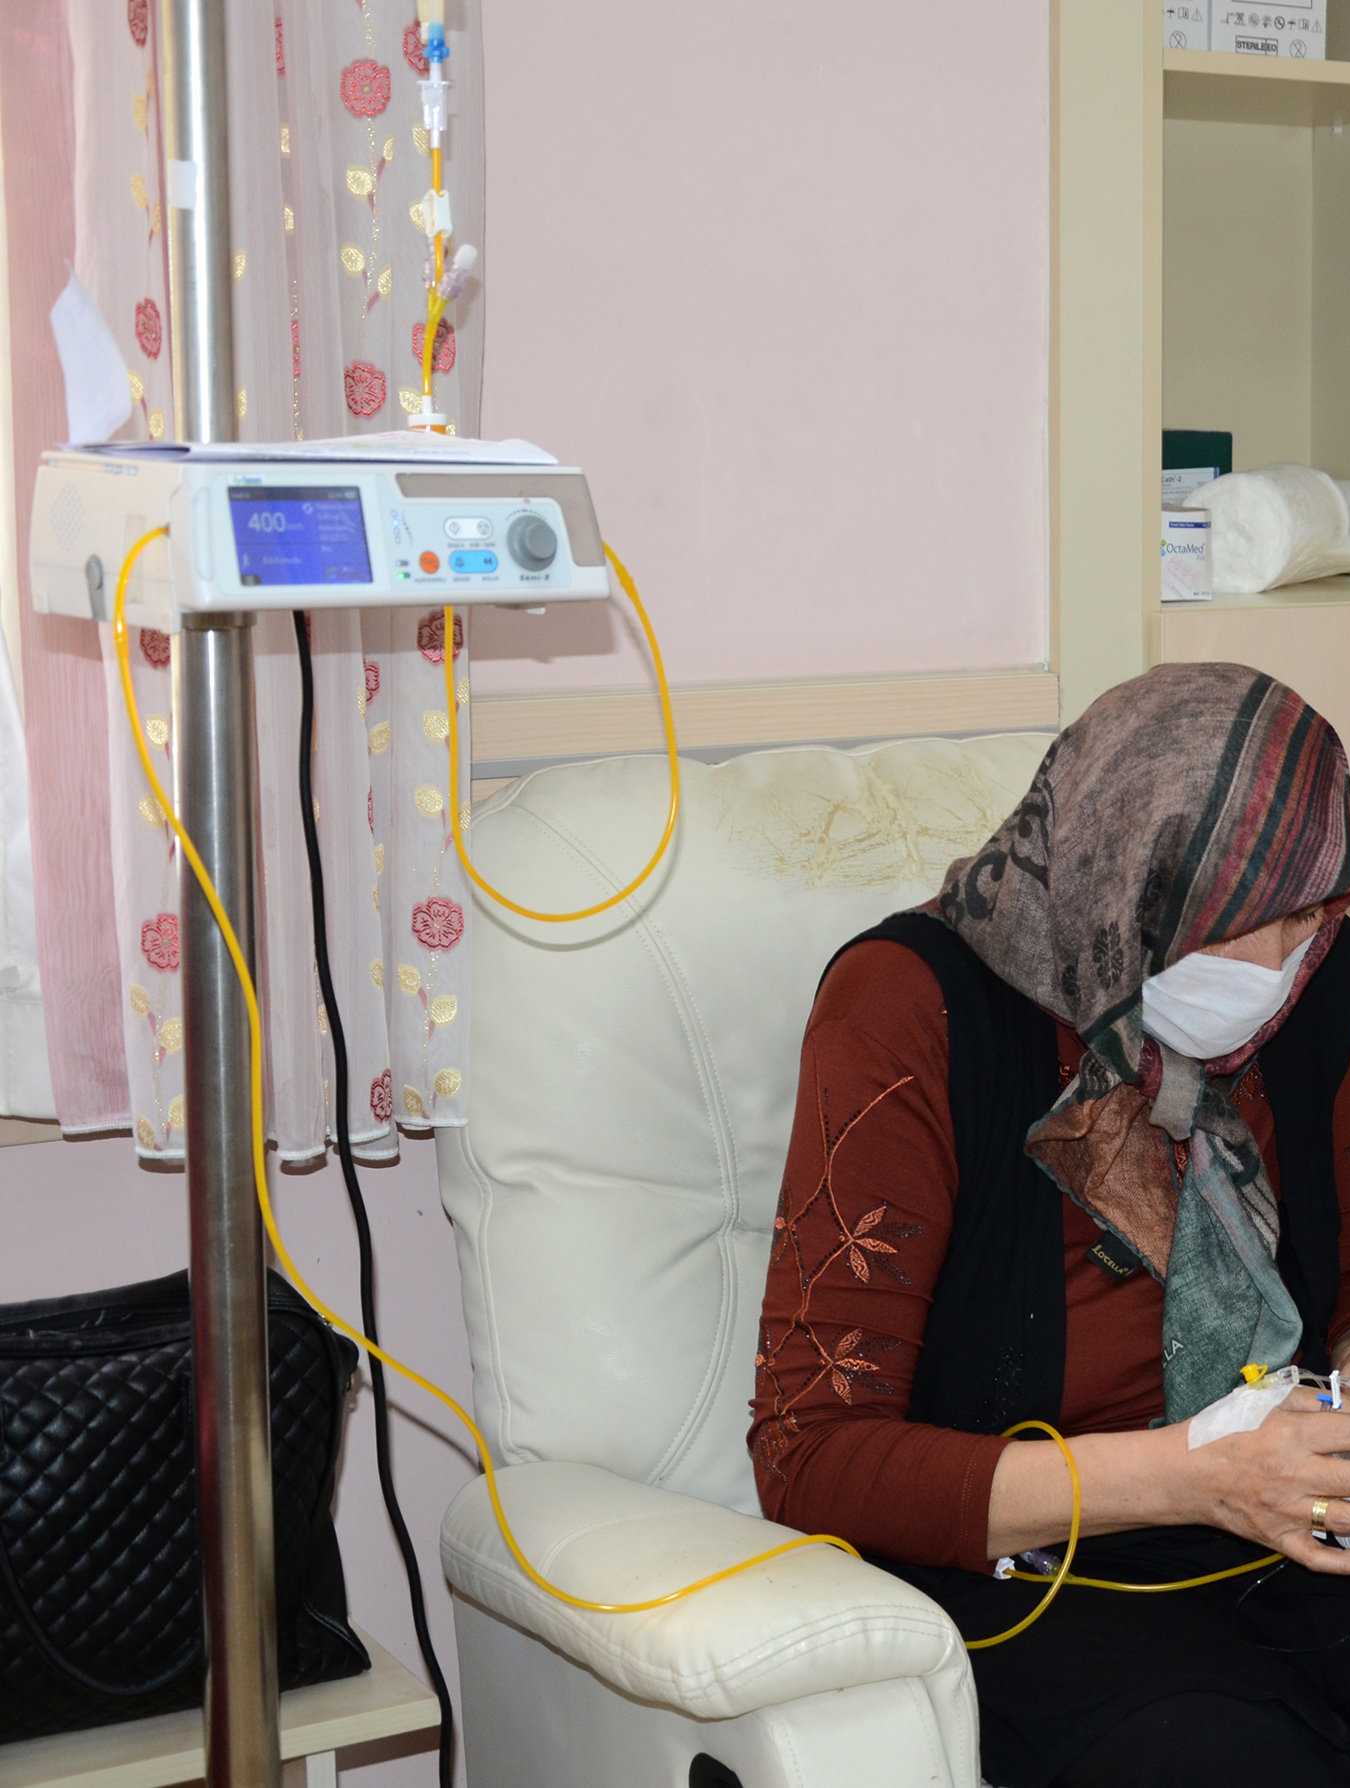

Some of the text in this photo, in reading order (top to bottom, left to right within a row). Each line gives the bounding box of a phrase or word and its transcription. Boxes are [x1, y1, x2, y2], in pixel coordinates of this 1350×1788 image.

[1236, 41, 1277, 52] STERILE EO
[248, 512, 286, 532] 400
[1166, 542, 1204, 554] OctaMed
